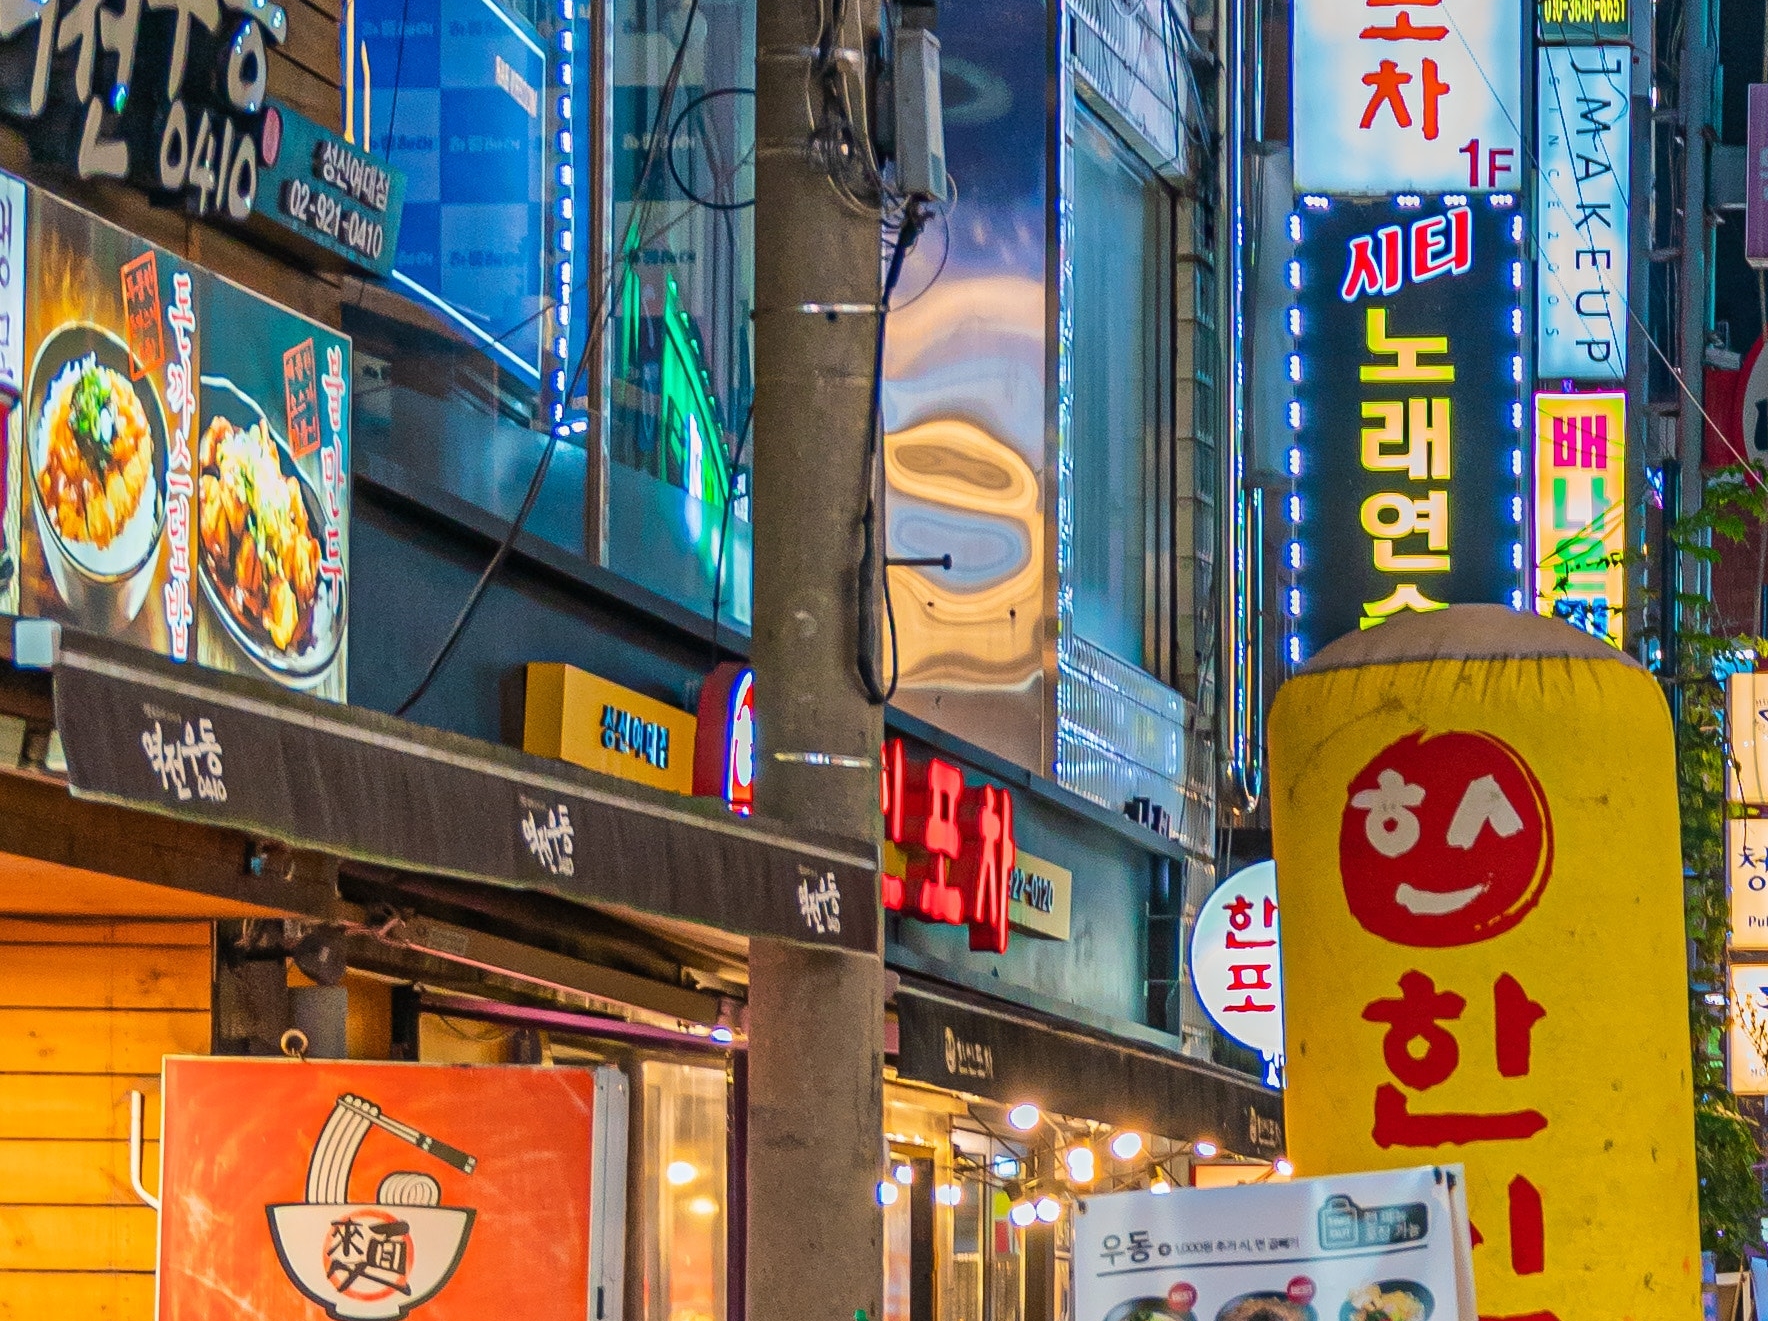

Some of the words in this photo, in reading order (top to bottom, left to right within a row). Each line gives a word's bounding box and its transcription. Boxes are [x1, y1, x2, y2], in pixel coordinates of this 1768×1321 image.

[1459, 139, 1514, 188] 1F
[289, 179, 383, 259] 02-921-0410
[1342, 207, 1473, 300] 시티
[1101, 1230, 1153, 1267] 우동
